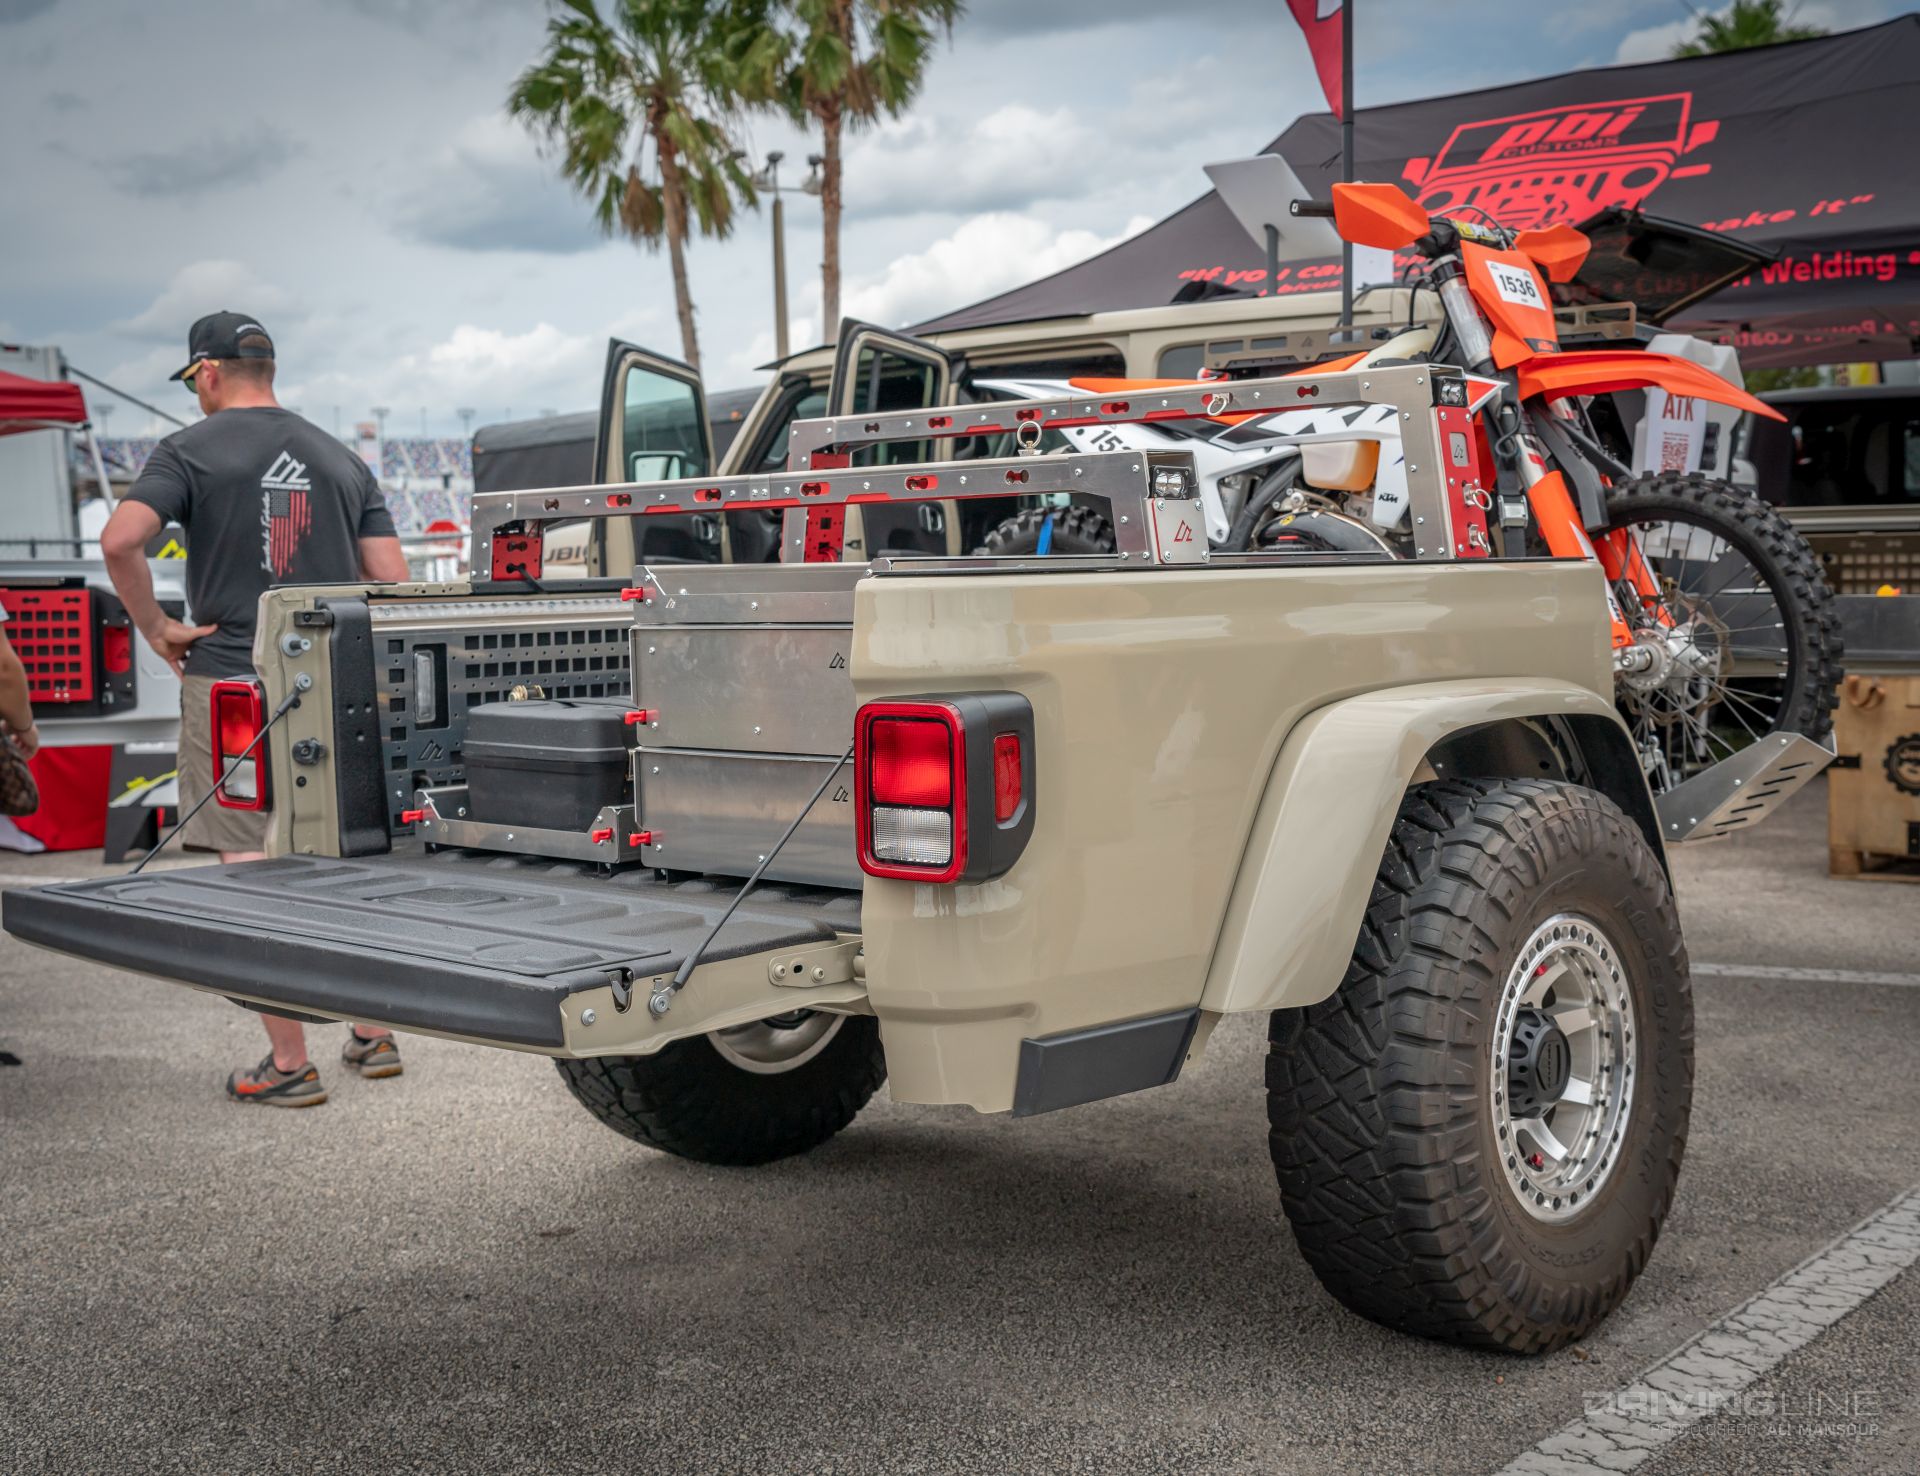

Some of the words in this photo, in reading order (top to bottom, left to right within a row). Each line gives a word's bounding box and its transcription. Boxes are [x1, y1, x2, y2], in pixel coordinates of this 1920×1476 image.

[1503, 135, 1620, 157] CUSTOMS
[1761, 250, 1897, 285] Welding
[1499, 274, 1536, 298] 1536
[1378, 492, 1399, 503] KTM
